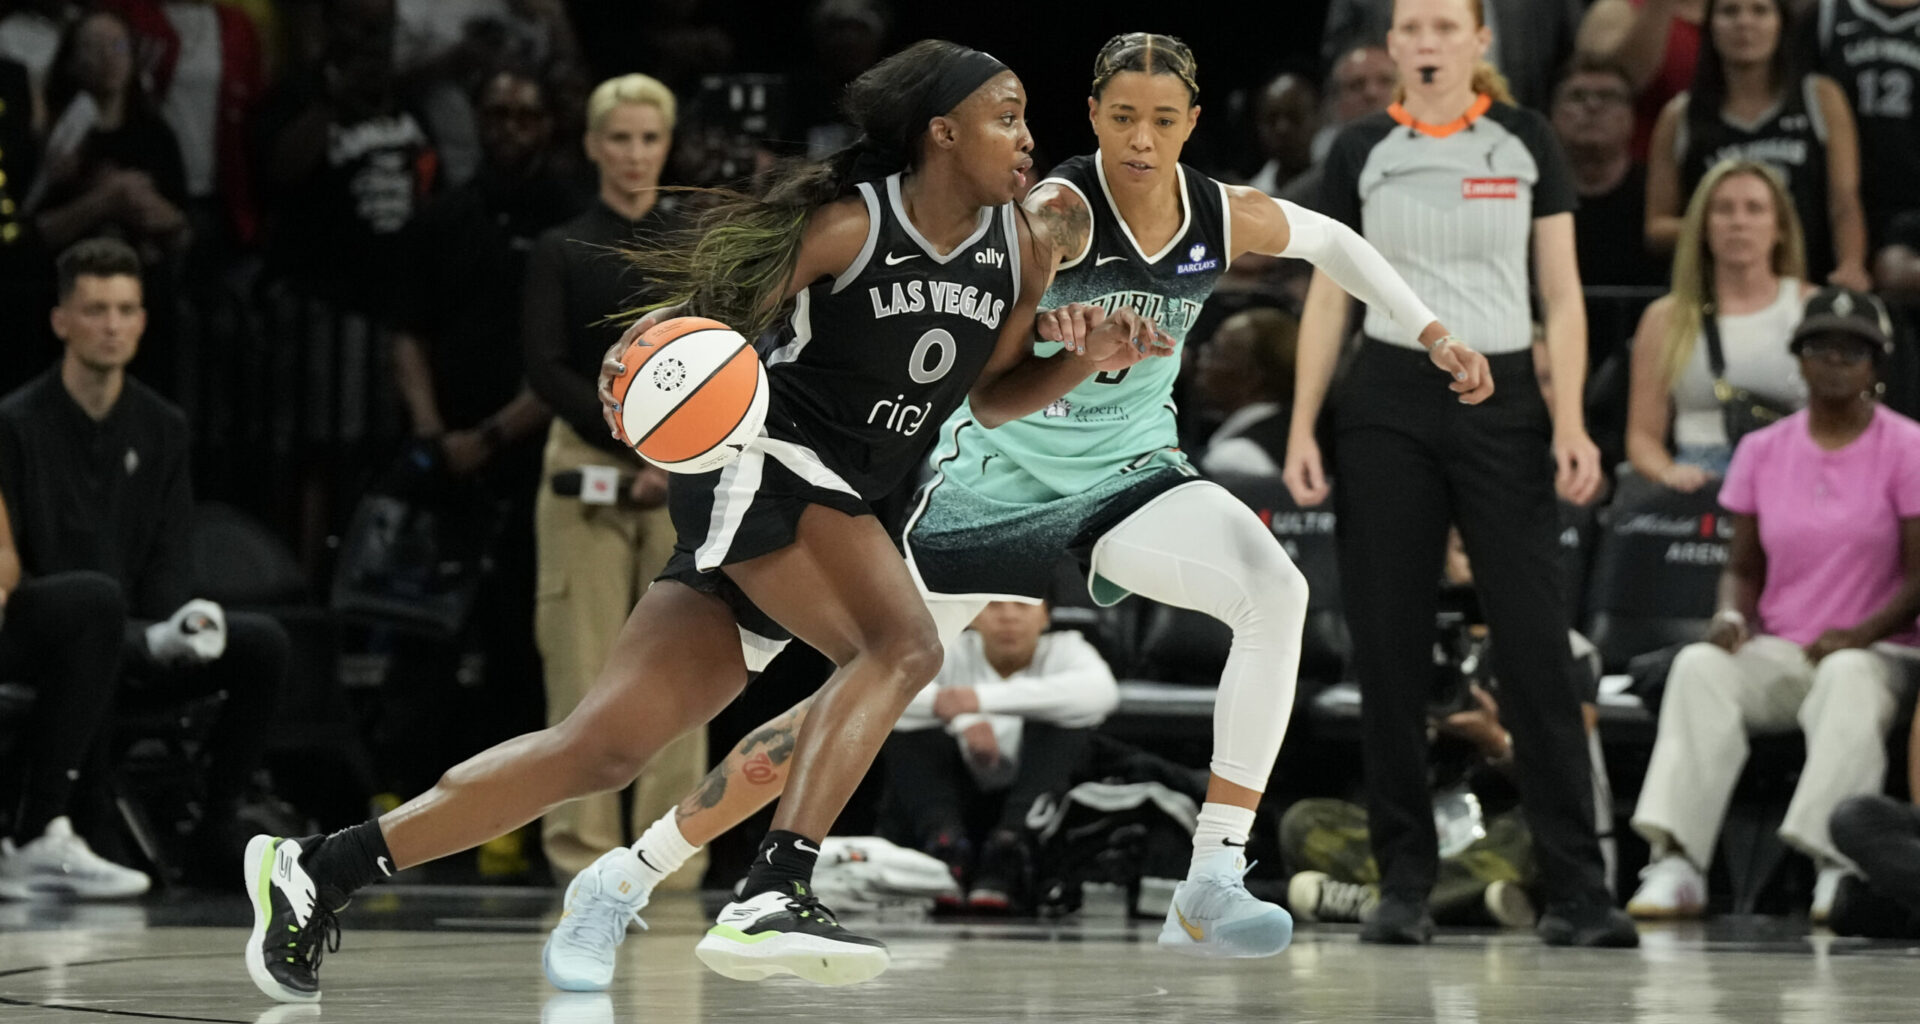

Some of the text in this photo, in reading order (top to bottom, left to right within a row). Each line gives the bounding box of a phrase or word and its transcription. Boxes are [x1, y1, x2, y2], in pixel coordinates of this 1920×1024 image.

[1857, 69, 1912, 117] 12
[974, 247, 1005, 269] ally
[1177, 259, 1217, 274] BARCLAYS
[868, 280, 1005, 330] LAS VEGAS
[908, 328, 957, 384] 0
[867, 394, 932, 437] ring
[1272, 511, 1336, 534] ULTR
[1664, 541, 1729, 563] AREN
